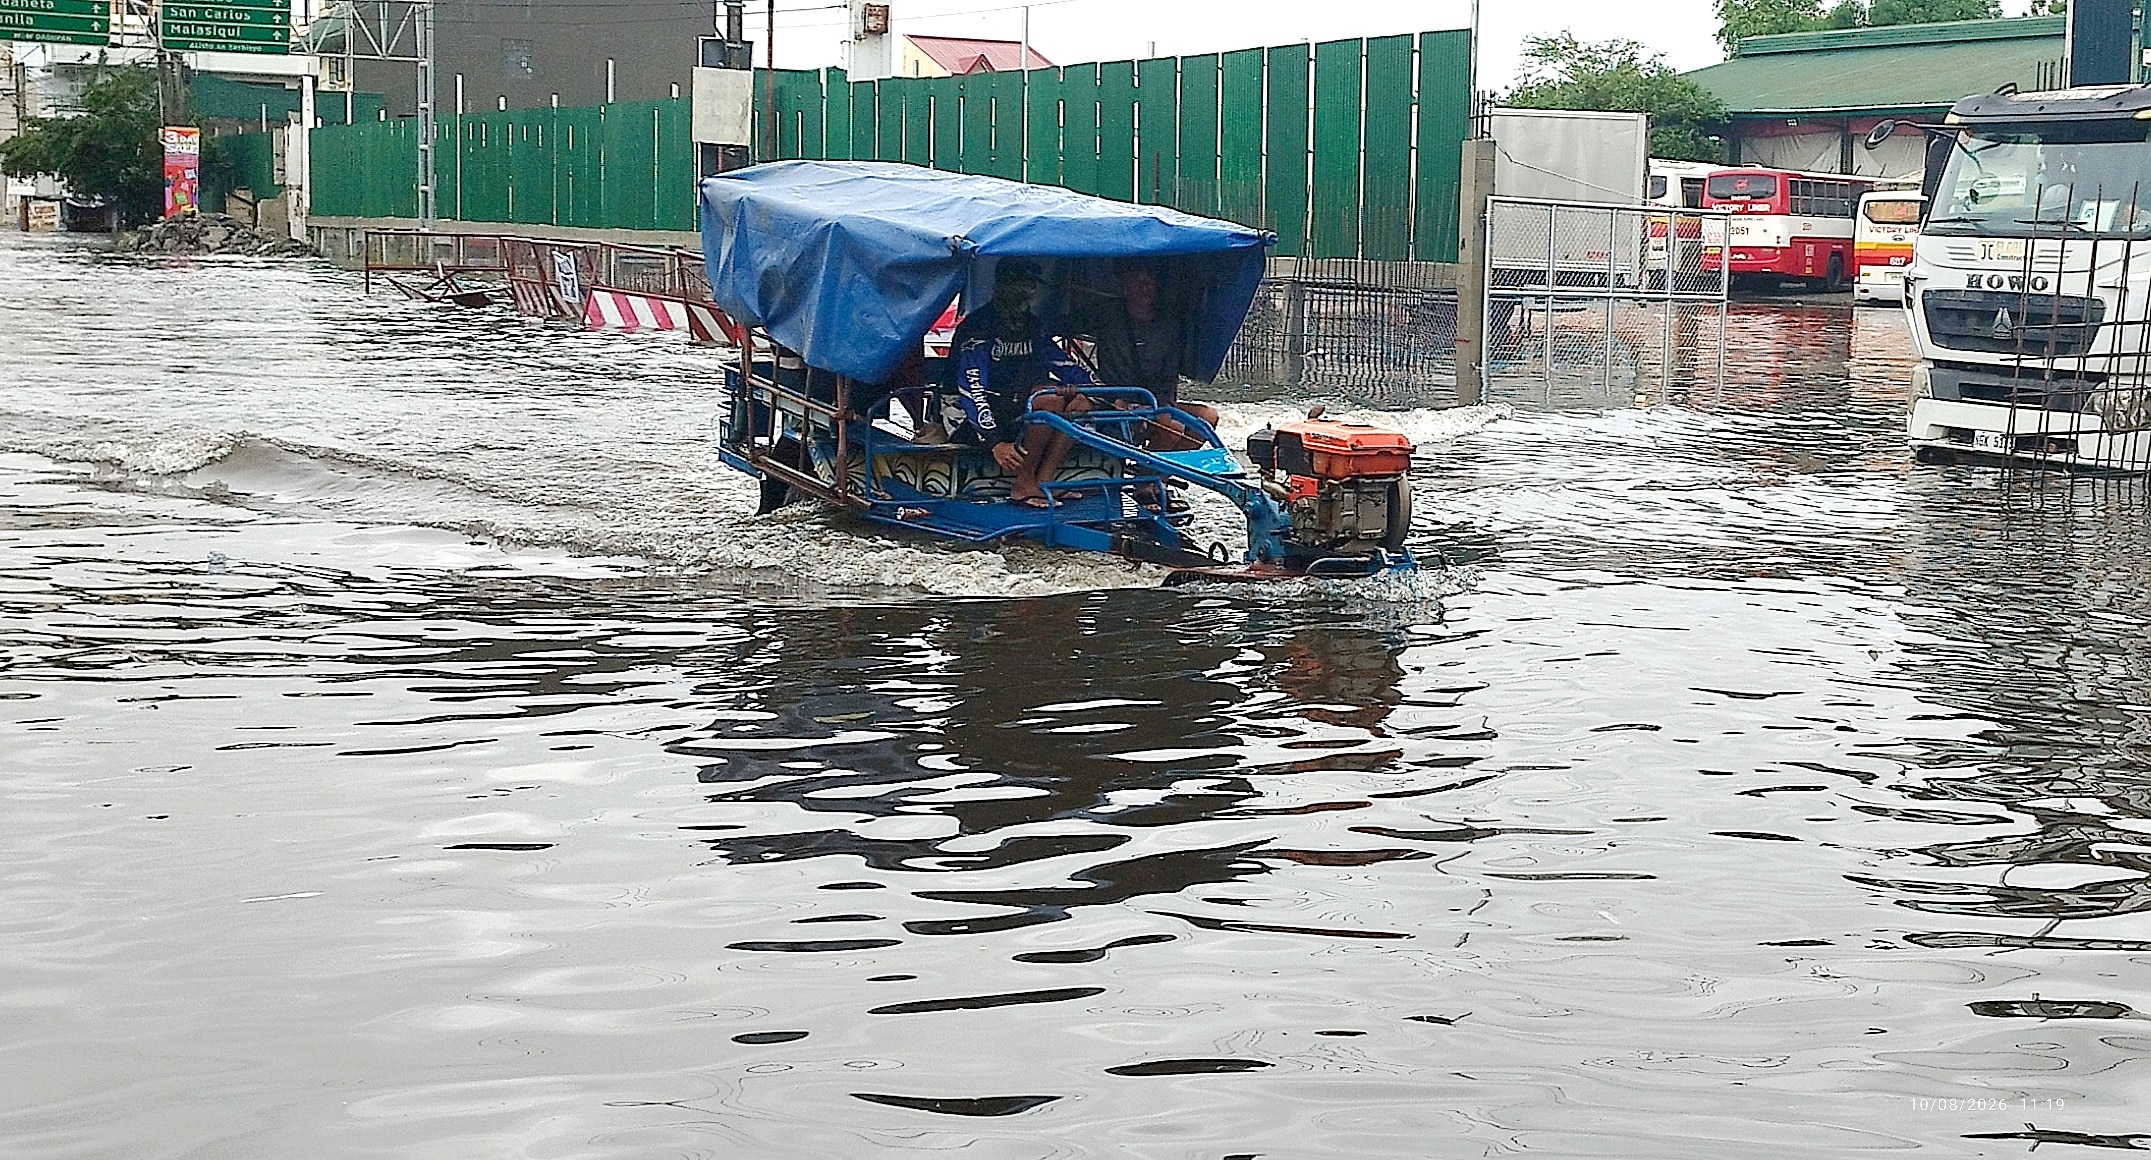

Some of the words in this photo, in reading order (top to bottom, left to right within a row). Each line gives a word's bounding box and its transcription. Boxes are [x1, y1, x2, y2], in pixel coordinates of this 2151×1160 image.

[170, 7, 197, 18] San
[204, 8, 252, 21] Carlos
[170, 24, 241, 38] Malasiqui
[165, 131, 179, 143] 3
[165, 144, 199, 154] SALE
[1711, 203, 1745, 213] VICTORY
[1747, 203, 1771, 212] LINER
[1868, 226, 1903, 234] VICTORY
[1966, 273, 2049, 291] HOWO
